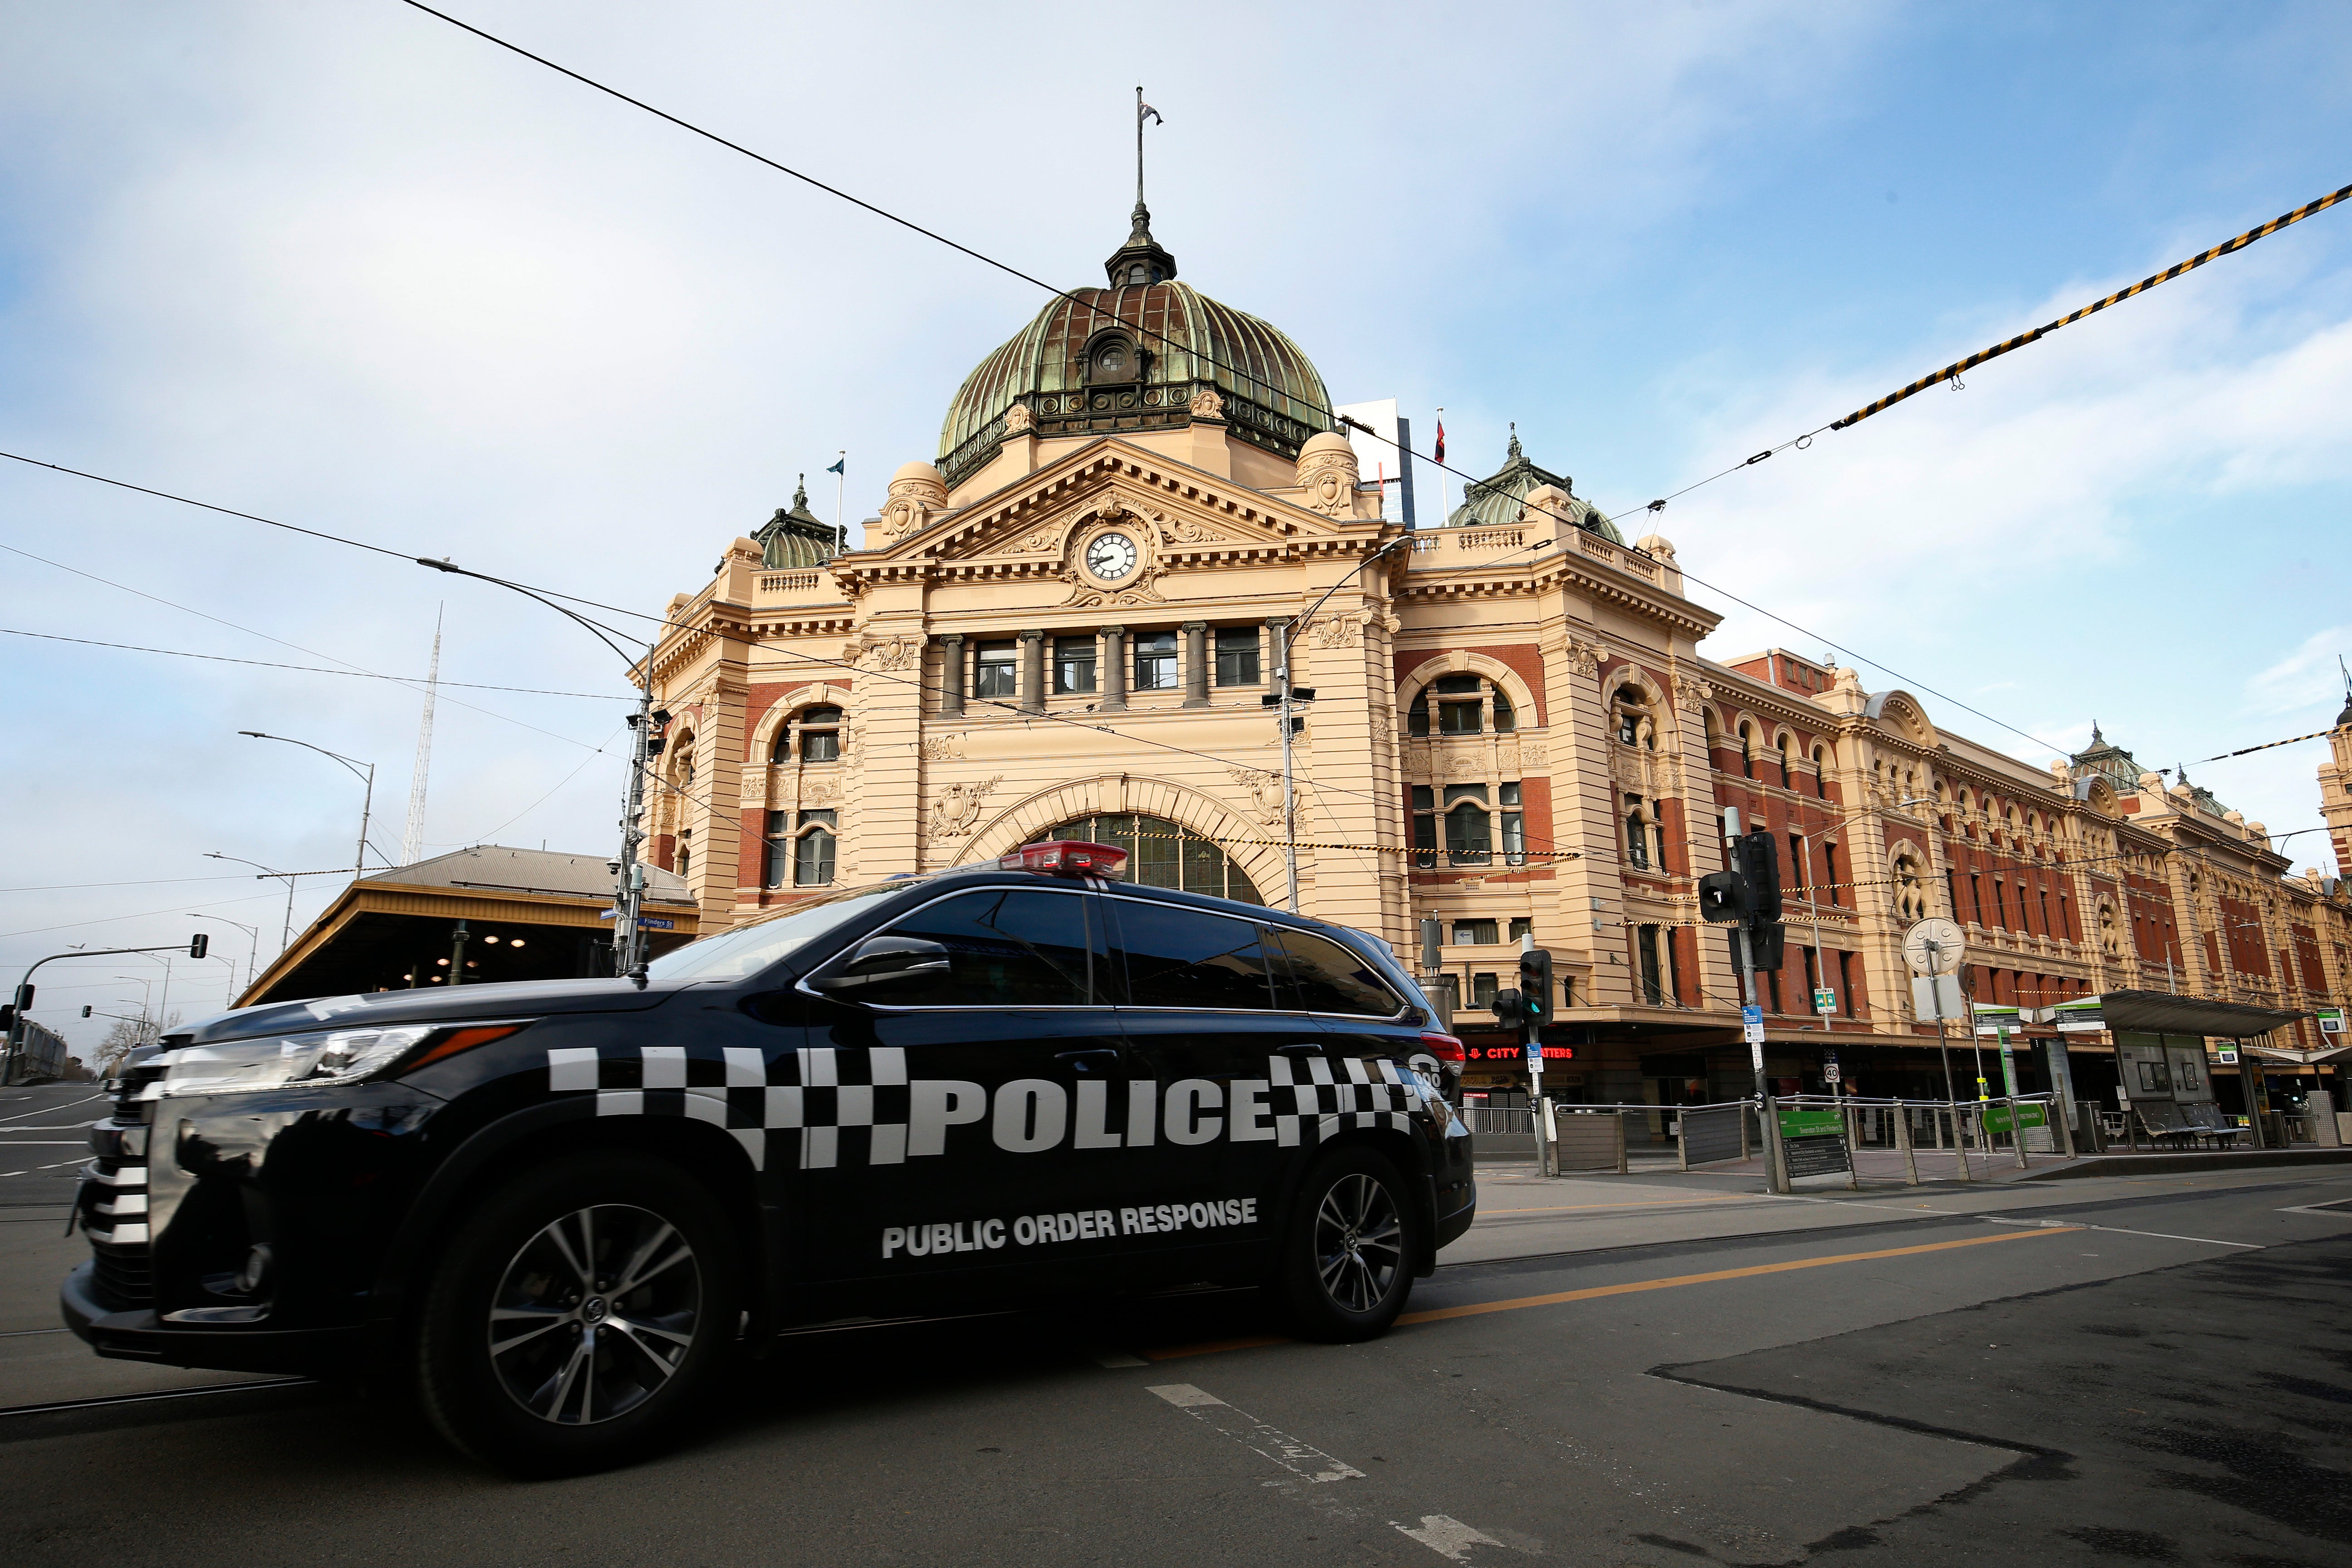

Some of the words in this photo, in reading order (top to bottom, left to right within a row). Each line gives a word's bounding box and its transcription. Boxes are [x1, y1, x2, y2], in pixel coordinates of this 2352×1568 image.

[1487, 1048, 1519, 1058] CITY
[1540, 1048, 1573, 1058] ATTERS
[1413, 1071, 1441, 1088] 000
[907, 1079, 1276, 1156] POLICE
[882, 1218, 1006, 1259] PUBLIC
[1013, 1210, 1117, 1246] ORDER
[1120, 1198, 1258, 1235] RESPONSE
